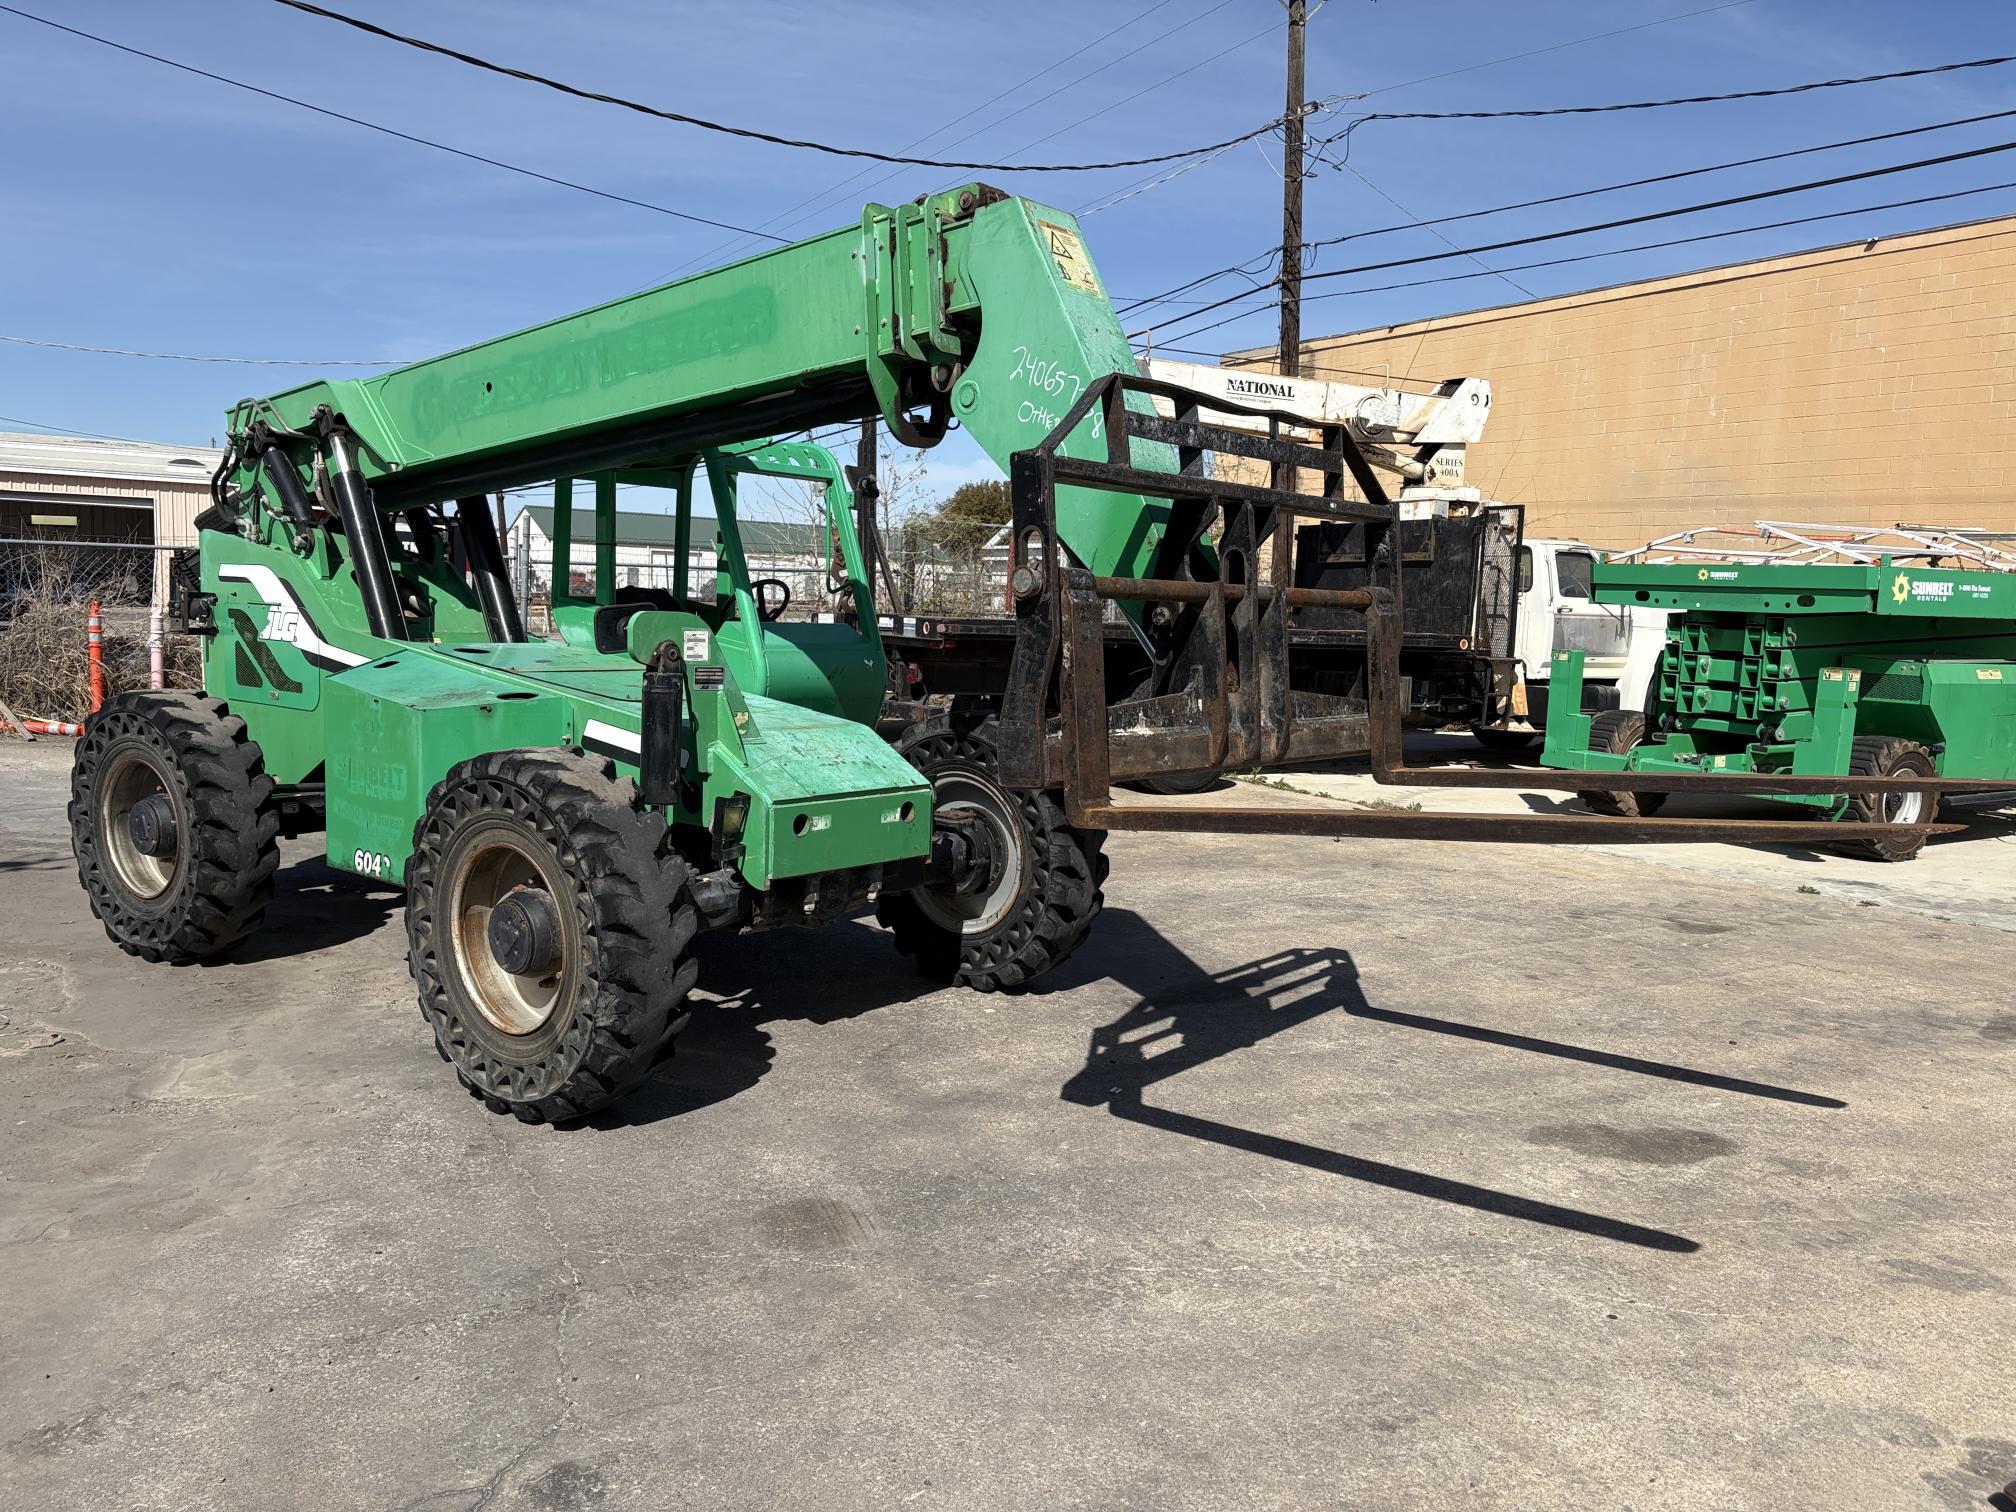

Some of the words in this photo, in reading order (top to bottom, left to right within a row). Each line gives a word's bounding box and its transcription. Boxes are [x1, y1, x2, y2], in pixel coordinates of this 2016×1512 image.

[1227, 379, 1296, 398] NATIONAL
[1436, 458, 1463, 467] SERIES
[1912, 581, 1953, 596] SUNBELT
